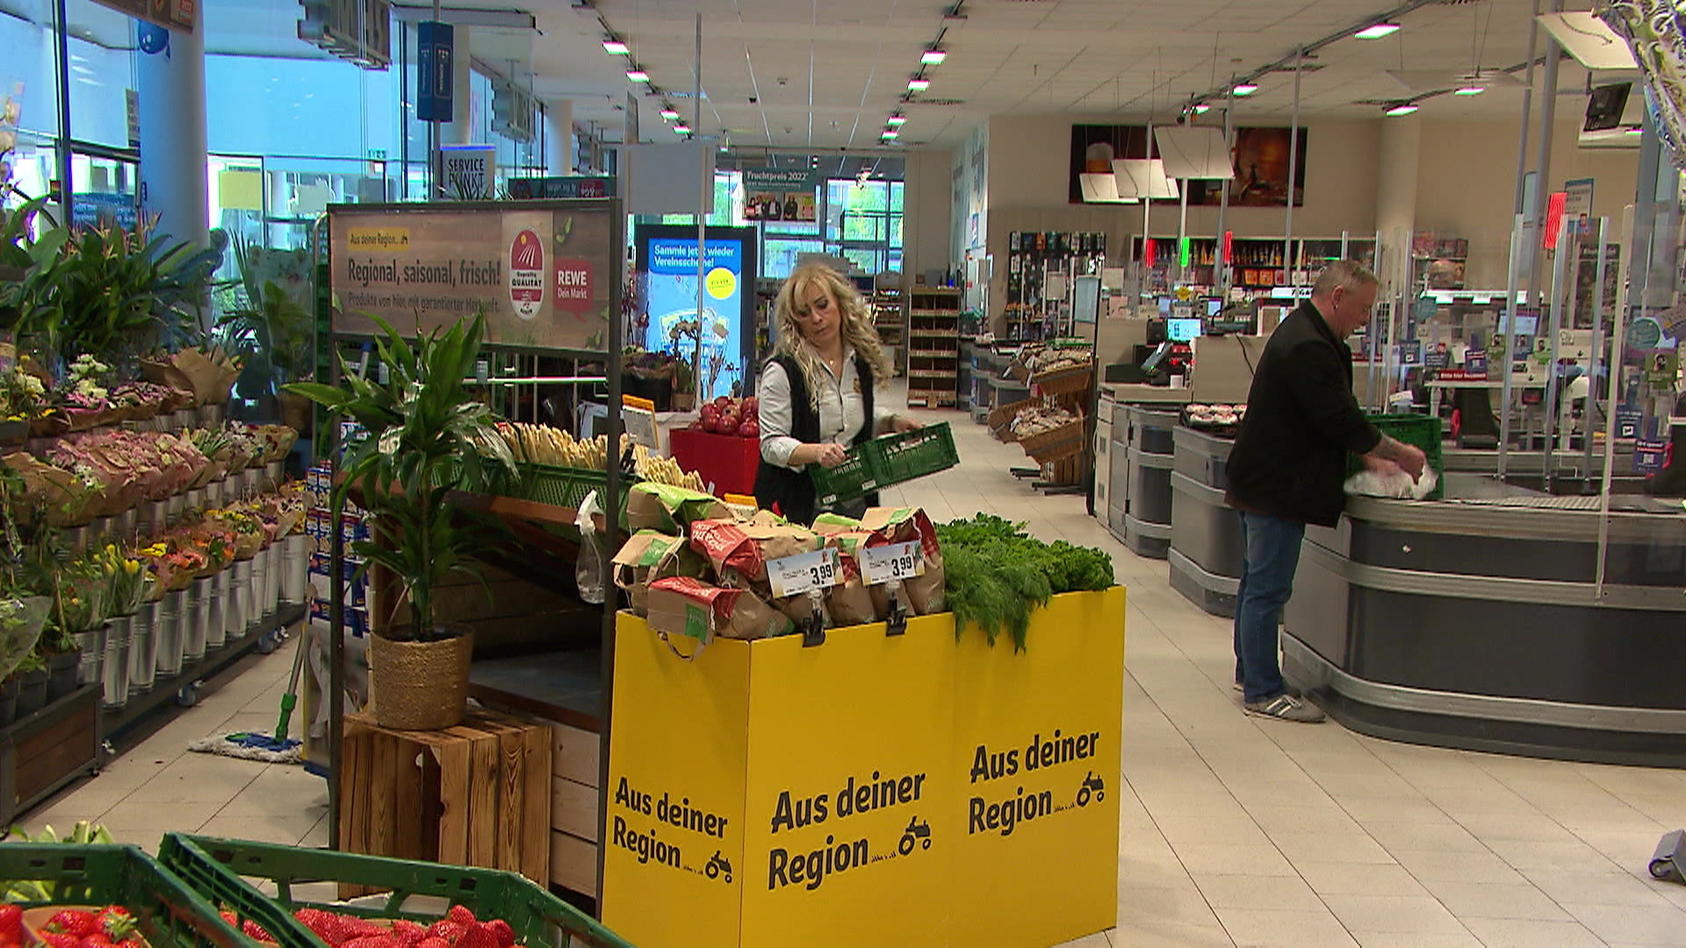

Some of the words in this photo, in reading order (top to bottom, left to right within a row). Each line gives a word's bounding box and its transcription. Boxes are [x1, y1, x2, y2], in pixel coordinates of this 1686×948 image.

[448, 158, 484, 171] SERVICE
[747, 170, 787, 183] Fruchtpreis
[350, 234, 361, 244] Aus
[654, 244, 686, 257] Sammle
[707, 246, 735, 257] wieder
[349, 258, 401, 287] Regional,
[403, 259, 456, 288] saisonal,
[459, 259, 501, 286] frisch!
[558, 270, 587, 286] REWE
[557, 287, 570, 298] Dein
[571, 287, 587, 299] Markt
[810, 564, 833, 585] 3.99
[970, 745, 1019, 784] Aus
[1025, 729, 1099, 771] deiner
[615, 776, 651, 816] Aus
[656, 792, 728, 838] deiner
[771, 790, 829, 834] Aus
[836, 770, 926, 818] deiner
[969, 786, 1052, 836] Region
[613, 815, 681, 864] Region
[768, 834, 868, 891] Region
